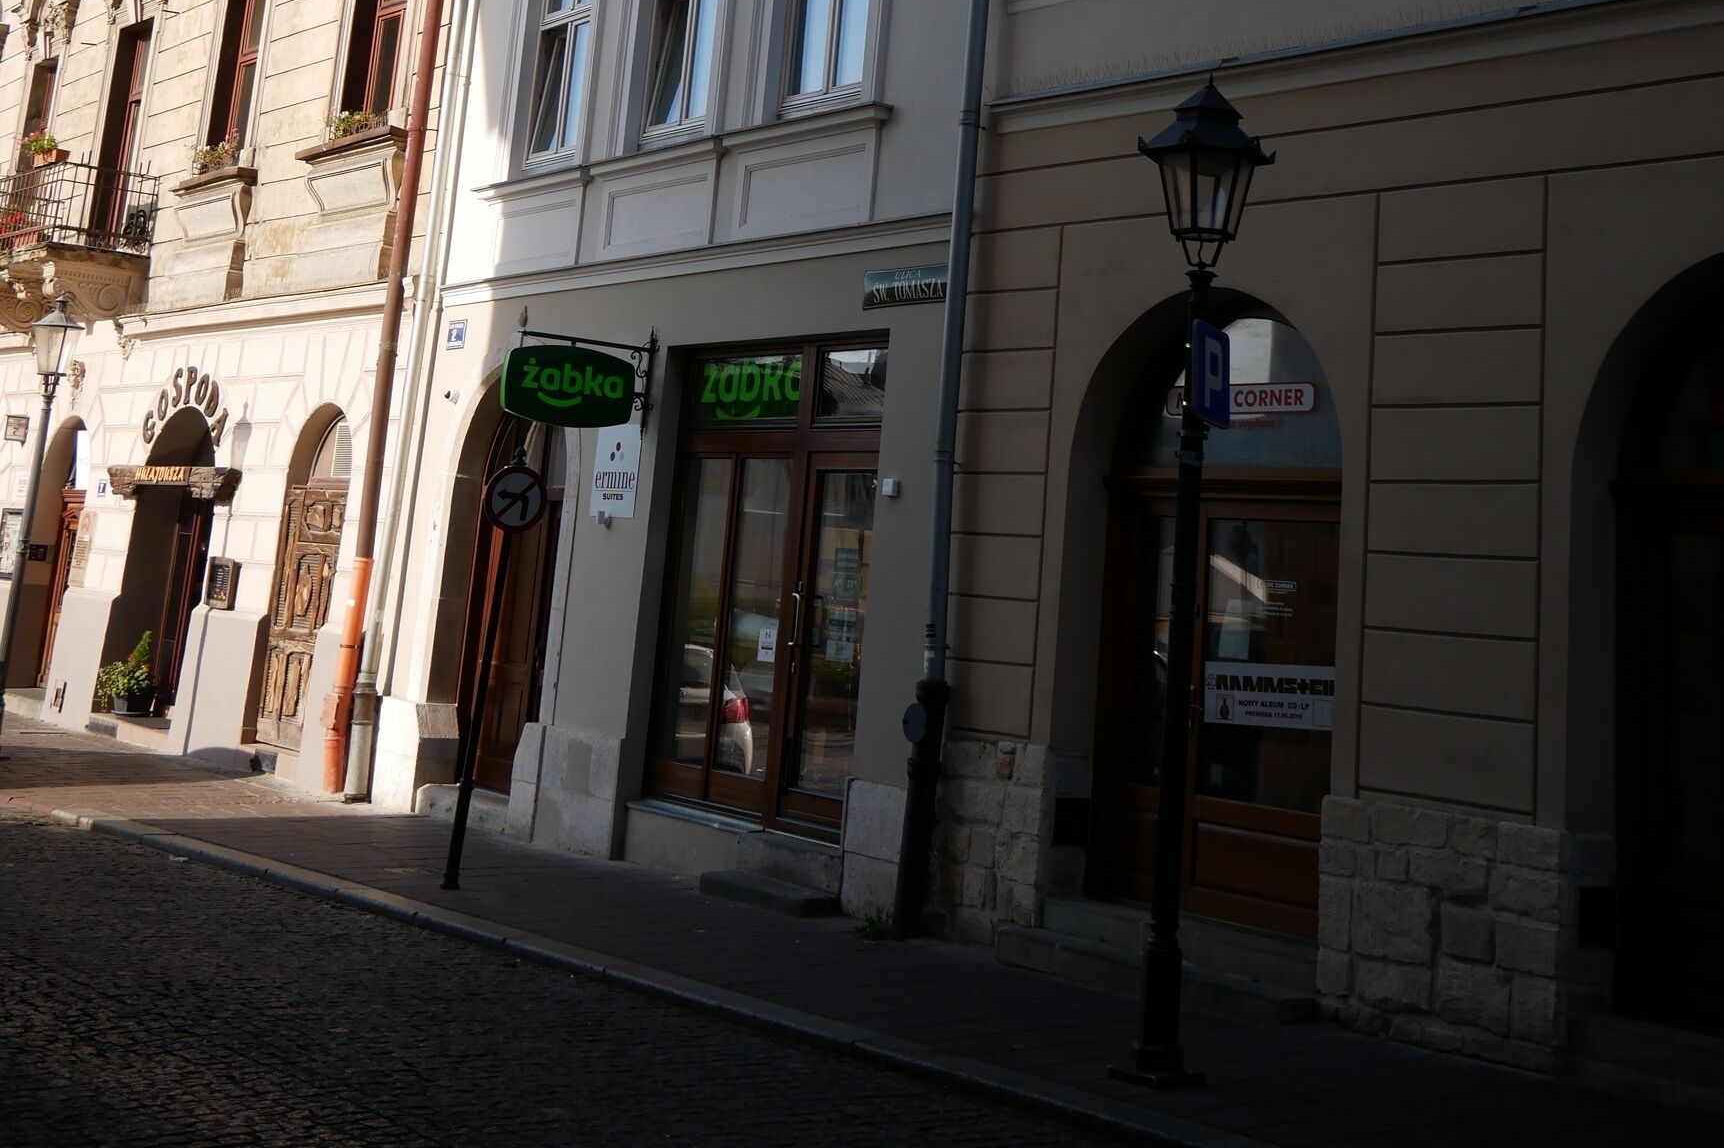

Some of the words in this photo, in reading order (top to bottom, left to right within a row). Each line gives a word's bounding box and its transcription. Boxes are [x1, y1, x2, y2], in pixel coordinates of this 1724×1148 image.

[895, 269, 921, 279] ULICA
[873, 282, 890, 303] ŚW.
[893, 278, 944, 301] TOMASZA
[451, 329, 457, 341] 2
[520, 357, 624, 399] żabka
[1204, 337, 1224, 409] P
[143, 366, 229, 447] GOSPODA
[1234, 389, 1304, 407] CORNER
[595, 470, 635, 490] ermine
[602, 493, 624, 501] SUITES
[1239, 699, 1258, 707] NOWY
[1261, 700, 1284, 709] ALBUM
